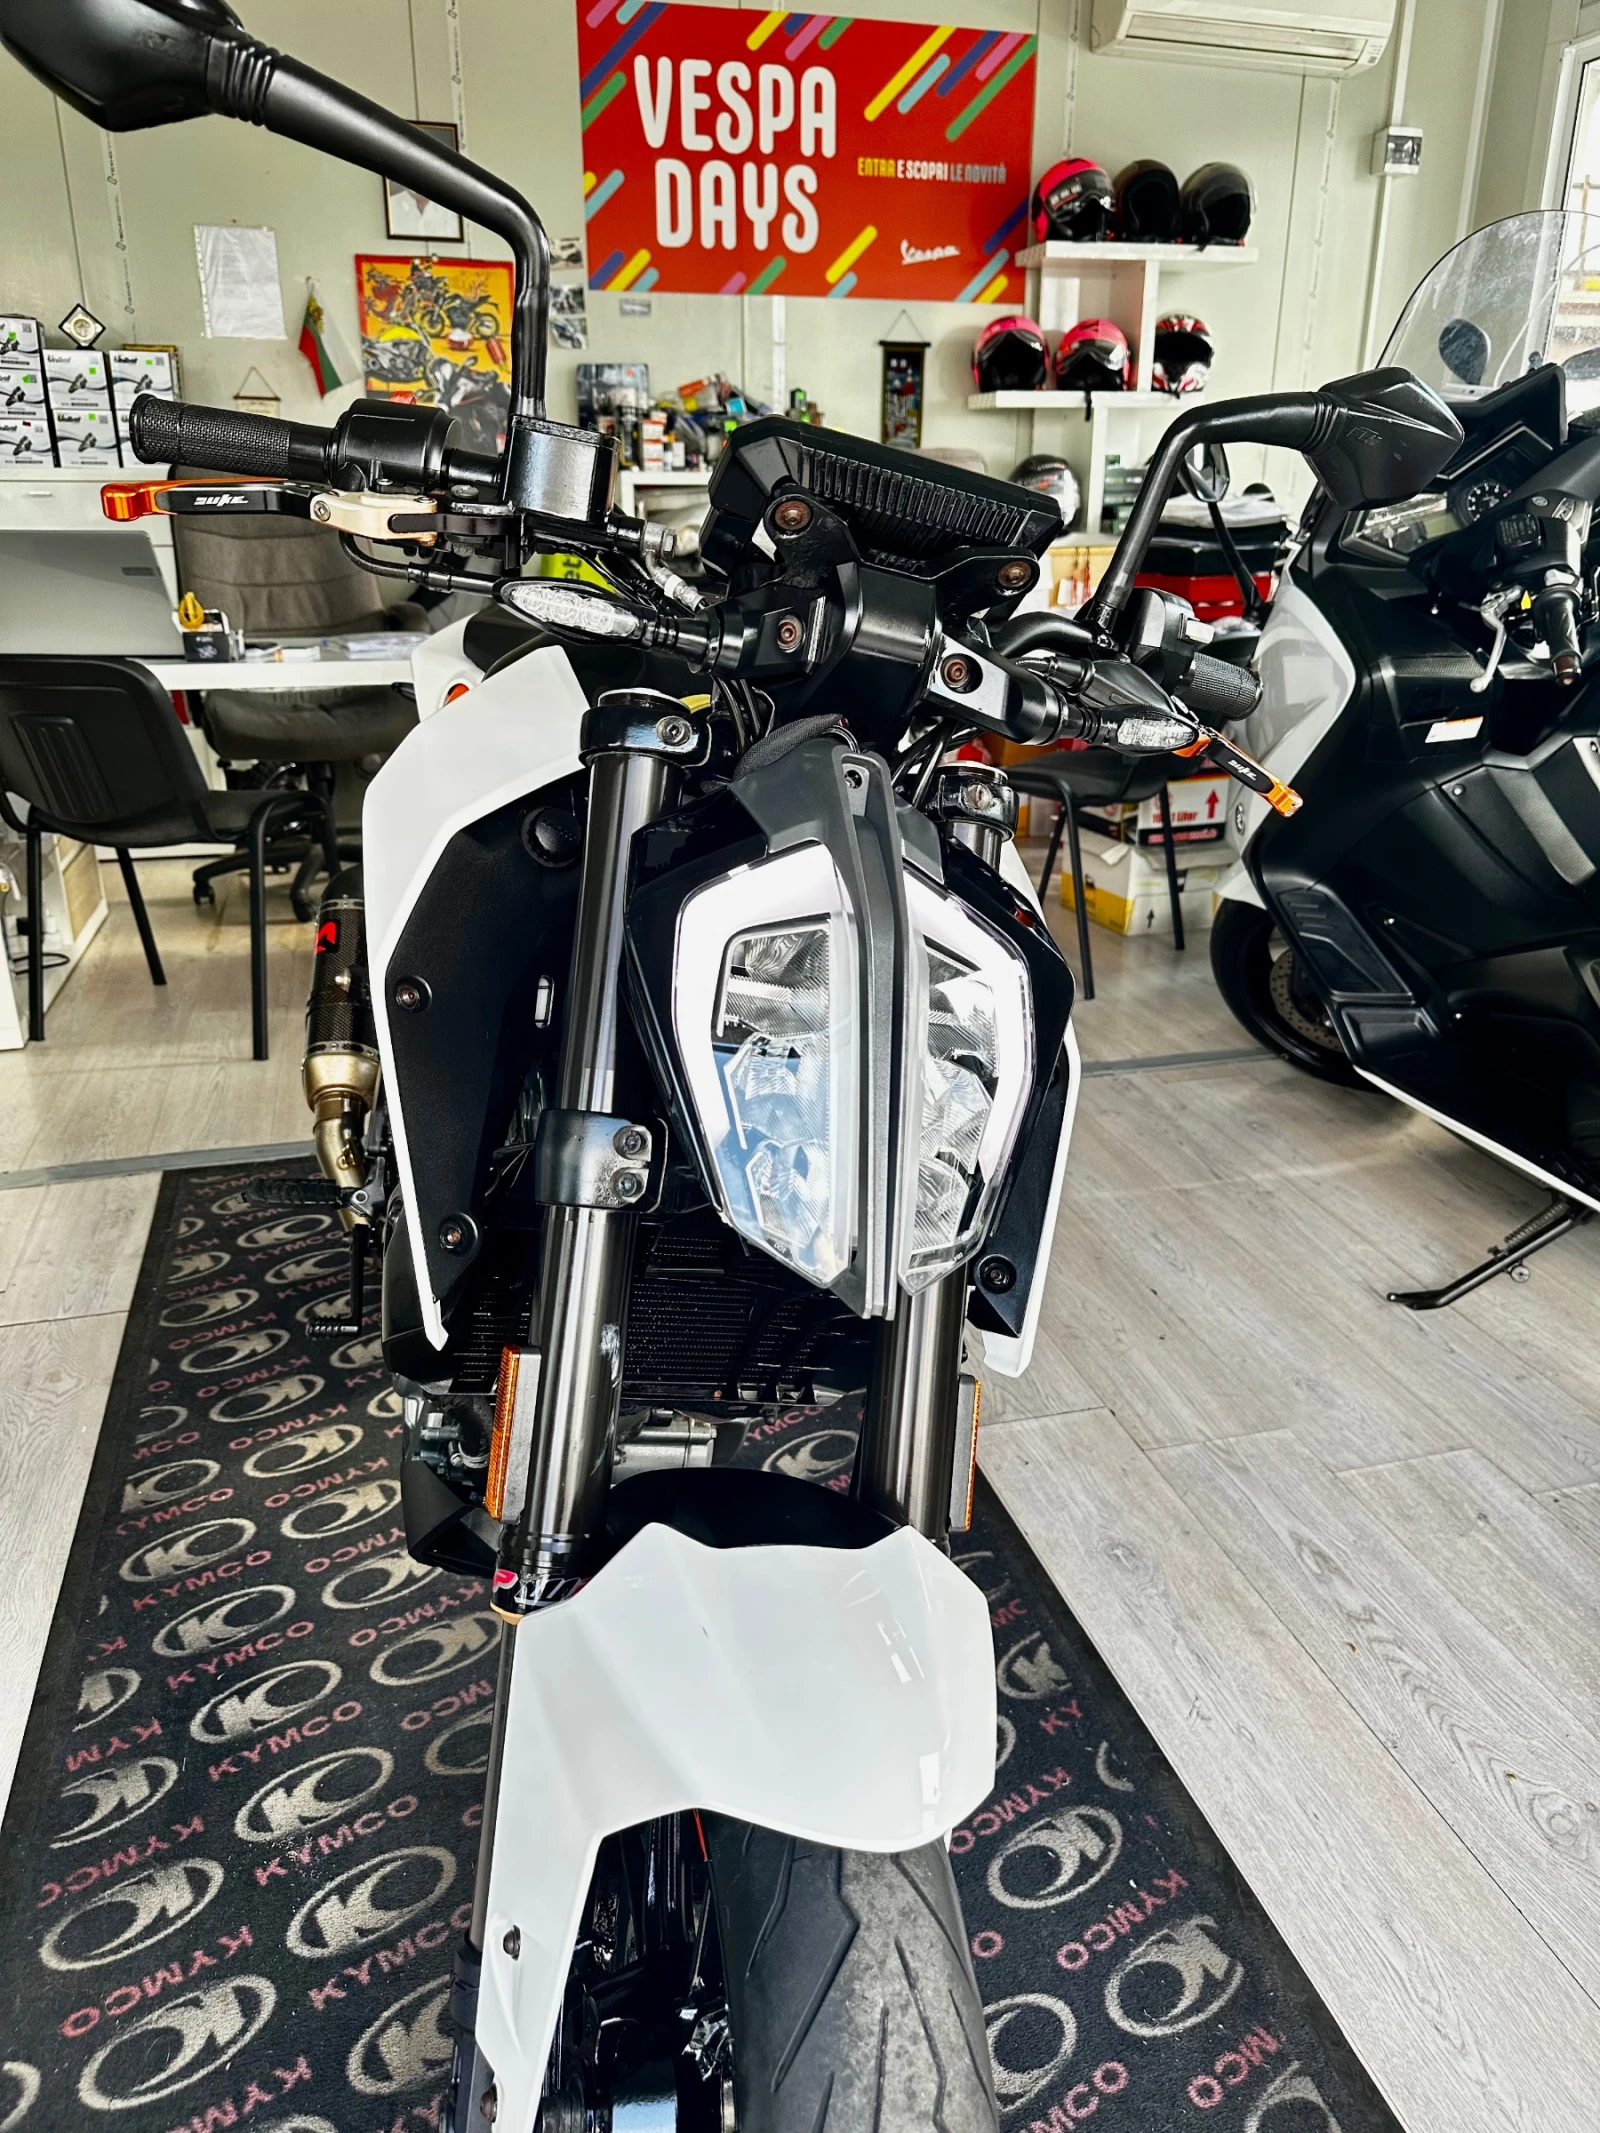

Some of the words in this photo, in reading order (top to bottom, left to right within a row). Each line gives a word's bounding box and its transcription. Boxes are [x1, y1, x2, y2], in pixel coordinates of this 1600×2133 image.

[633, 54, 837, 159] VESPA
[857, 157, 896, 177] ENTRA
[897, 159, 905, 179] E
[906, 160, 949, 181] SCOPRI
[950, 163, 962, 183] LE
[964, 162, 1007, 185] NOVITÀ
[654, 158, 819, 254] DAYS
[900, 238, 961, 265] Vespa
[249, 1230, 344, 1261] KYMCO
[169, 1312, 277, 1350] KYMCO
[197, 1355, 311, 1397] KYMCO
[228, 1404, 348, 1450] KYMCO
[265, 1456, 389, 1508] KYMCO
[133, 1549, 272, 1611] KYMCO
[348, 1581, 485, 1647] KYMCO
[166, 1621, 314, 1690] KYMCO
[207, 1700, 362, 1782] KYMCO
[255, 1795, 418, 1886] KYMCO
[950, 1767, 1071, 1854] KYMCO
[1056, 1869, 1188, 1971] KYMCO
[61, 1924, 254, 2038] KYMCO
